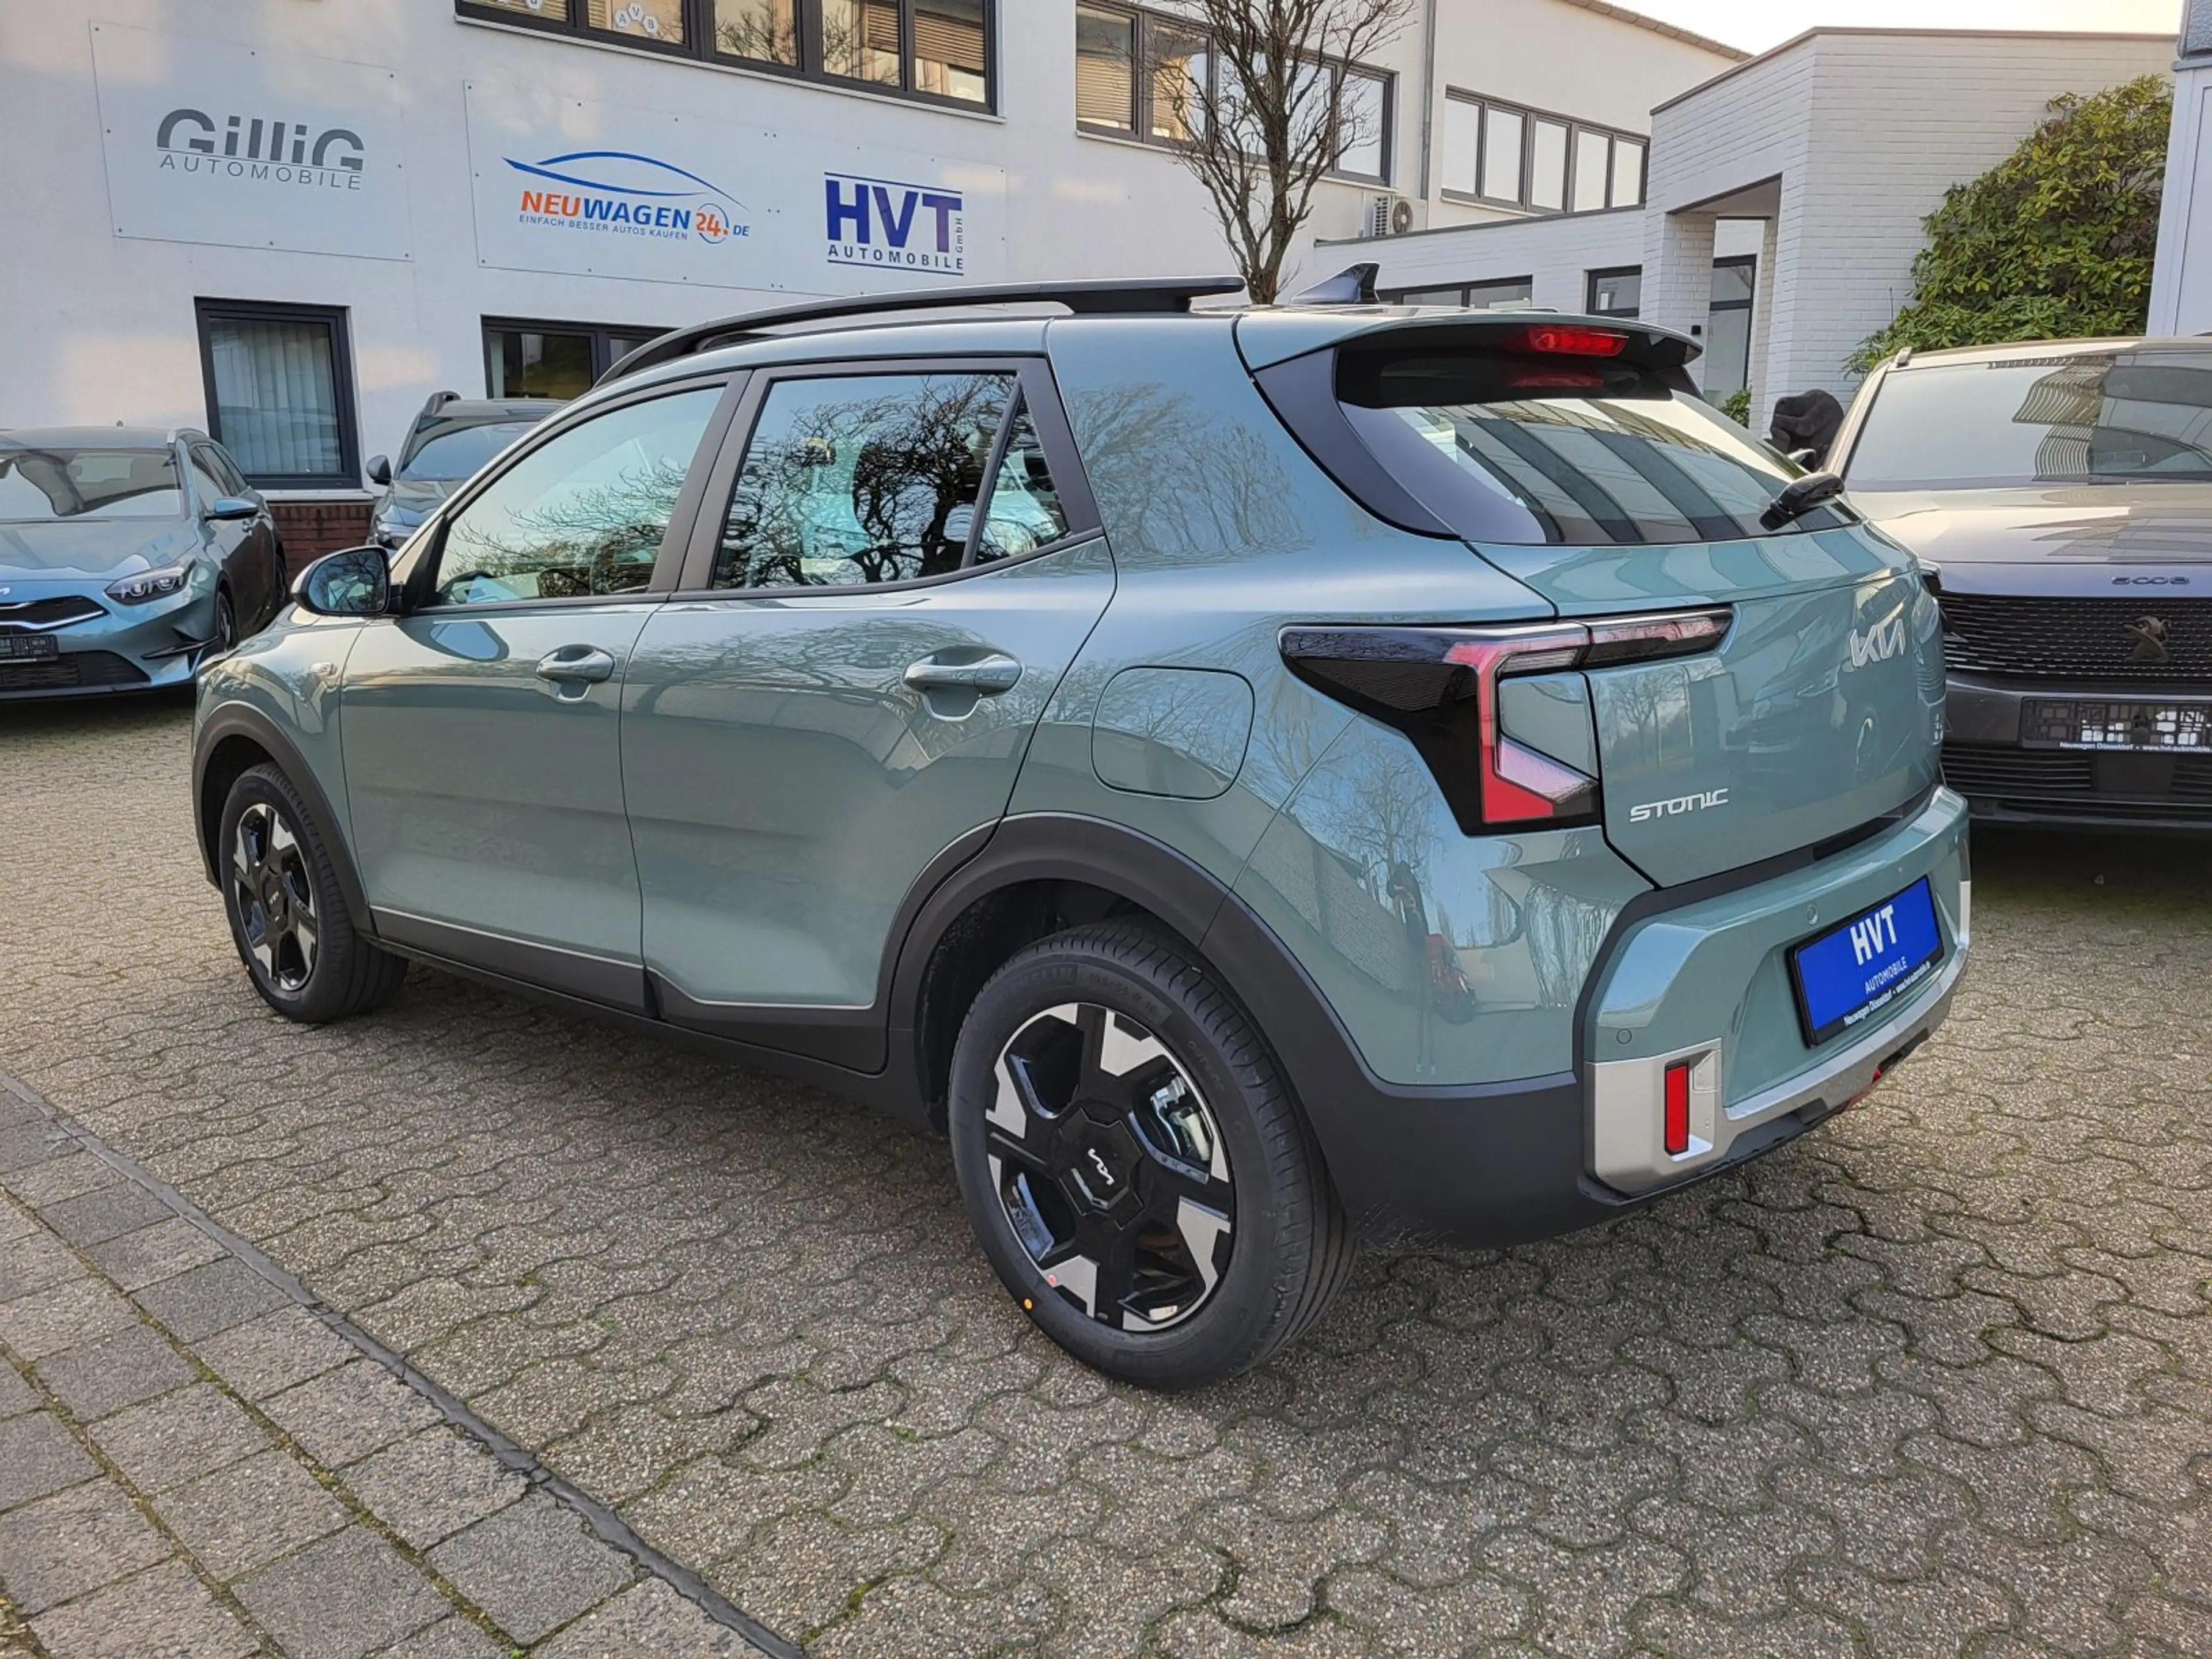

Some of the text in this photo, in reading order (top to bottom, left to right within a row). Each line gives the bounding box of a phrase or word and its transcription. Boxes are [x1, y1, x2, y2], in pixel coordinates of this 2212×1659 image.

[159, 154, 361, 191] AUTOMOBILE
[519, 214, 688, 241] EINFACH BESSER AUTOS KAUFEN
[825, 179, 962, 253] HVT
[955, 217, 963, 254] GmbH
[828, 244, 964, 270] AUTOMOBILE
[1850, 618, 1906, 668] KIA
[1630, 788, 1729, 823] STONIC
[1850, 904, 1896, 965] HVT
[1865, 956, 1907, 995] AUTOMOBILE
